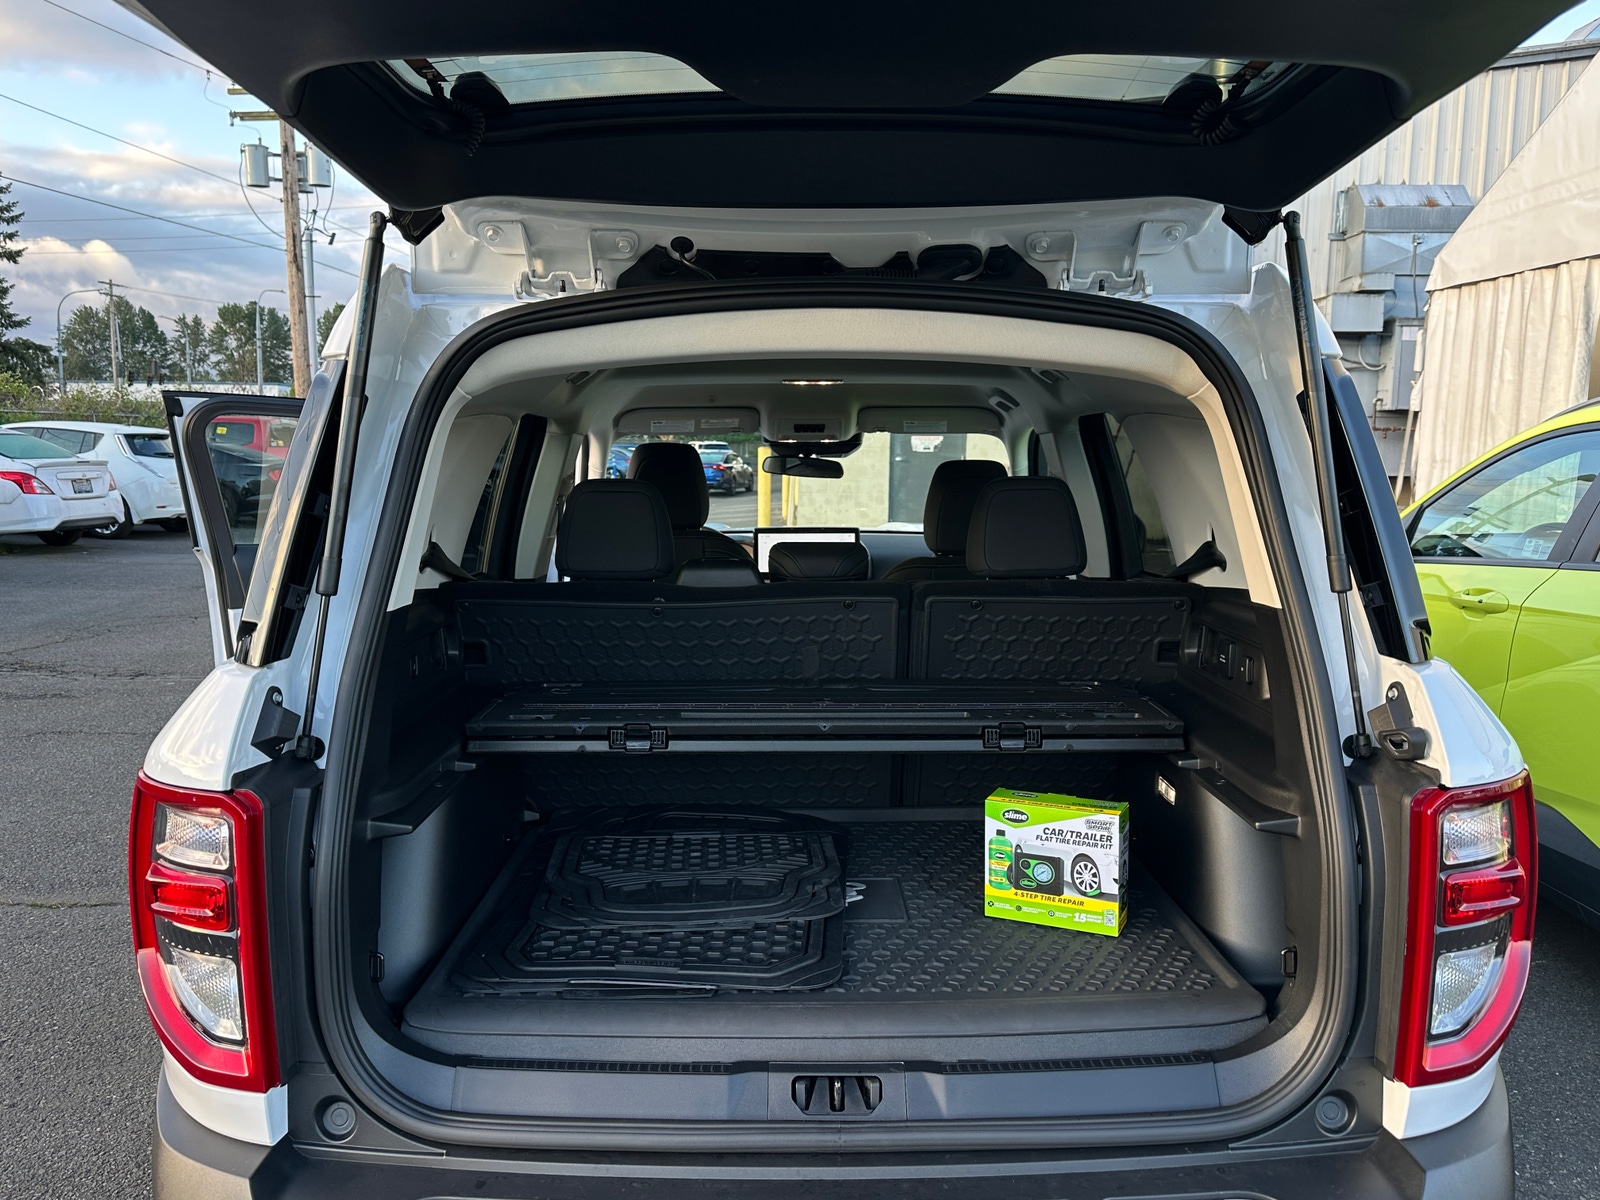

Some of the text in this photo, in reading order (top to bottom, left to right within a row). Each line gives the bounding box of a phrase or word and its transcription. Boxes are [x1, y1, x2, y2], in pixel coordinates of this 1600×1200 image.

[1004, 810, 1028, 821] slime
[1036, 835, 1054, 843] FLAT
[1055, 837, 1071, 845] TIRE
[1072, 839, 1099, 848] REPAIR
[1043, 827, 1113, 843] CAR/TRAILER
[1013, 892, 1085, 907] 4-STEP TIRE REPAIR
[1073, 912, 1087, 923] 15
